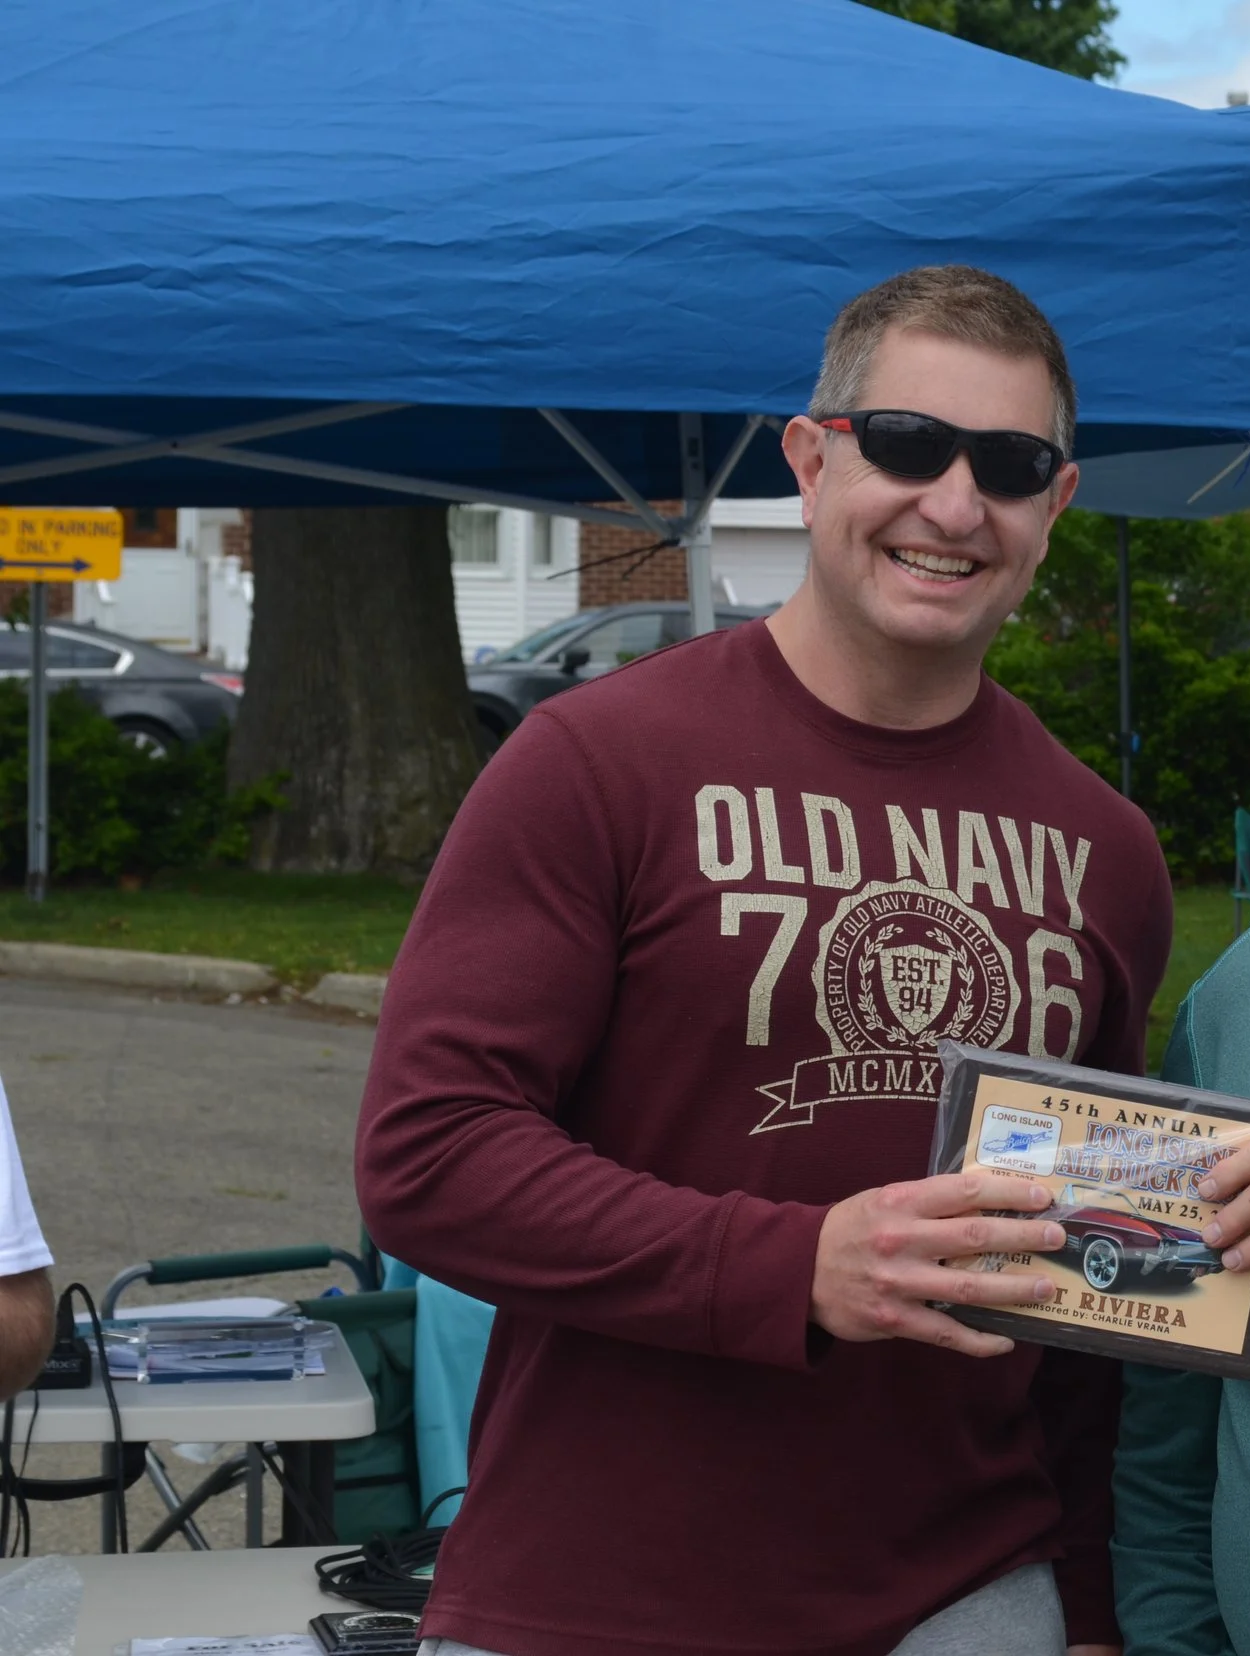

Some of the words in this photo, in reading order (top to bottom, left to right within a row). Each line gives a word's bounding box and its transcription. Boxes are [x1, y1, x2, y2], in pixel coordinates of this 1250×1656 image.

[18, 520, 36, 536] IN
[44, 520, 121, 537] PARKING
[15, 540, 61, 554] ONLY
[695, 784, 861, 889] OLD
[885, 804, 1091, 930] NAVY
[868, 894, 910, 916] NAVY
[843, 907, 871, 936] OLD
[915, 896, 988, 951] ATHLETIC
[832, 933, 850, 957] OF
[720, 892, 808, 1046] 7
[1027, 928, 1083, 1064] 6
[891, 955, 944, 986] EST.
[828, 960, 866, 1052] PROPERTY
[899, 986, 933, 1014] 94
[969, 952, 1006, 1048] DEPARTME
[991, 1111, 1017, 1123] LONG
[1020, 1117, 1053, 1129] ISLAND
[1041, 1095, 1099, 1118] 45th
[1115, 1109, 1218, 1139] ANNUAL
[1084, 1121, 1155, 1161] LONG
[993, 1155, 1037, 1170] CHAPTER
[1056, 1147, 1104, 1182] ALL
[1106, 1156, 1186, 1197] BUICK
[1137, 1196, 1175, 1215] MAY
[1179, 1203, 1204, 1222] 25,
[1072, 1309, 1088, 1324] by:
[1092, 1313, 1133, 1328] CHARLIE
[1137, 1321, 1171, 1335] VRANA
[1079, 1292, 1187, 1328] RIVIERA
